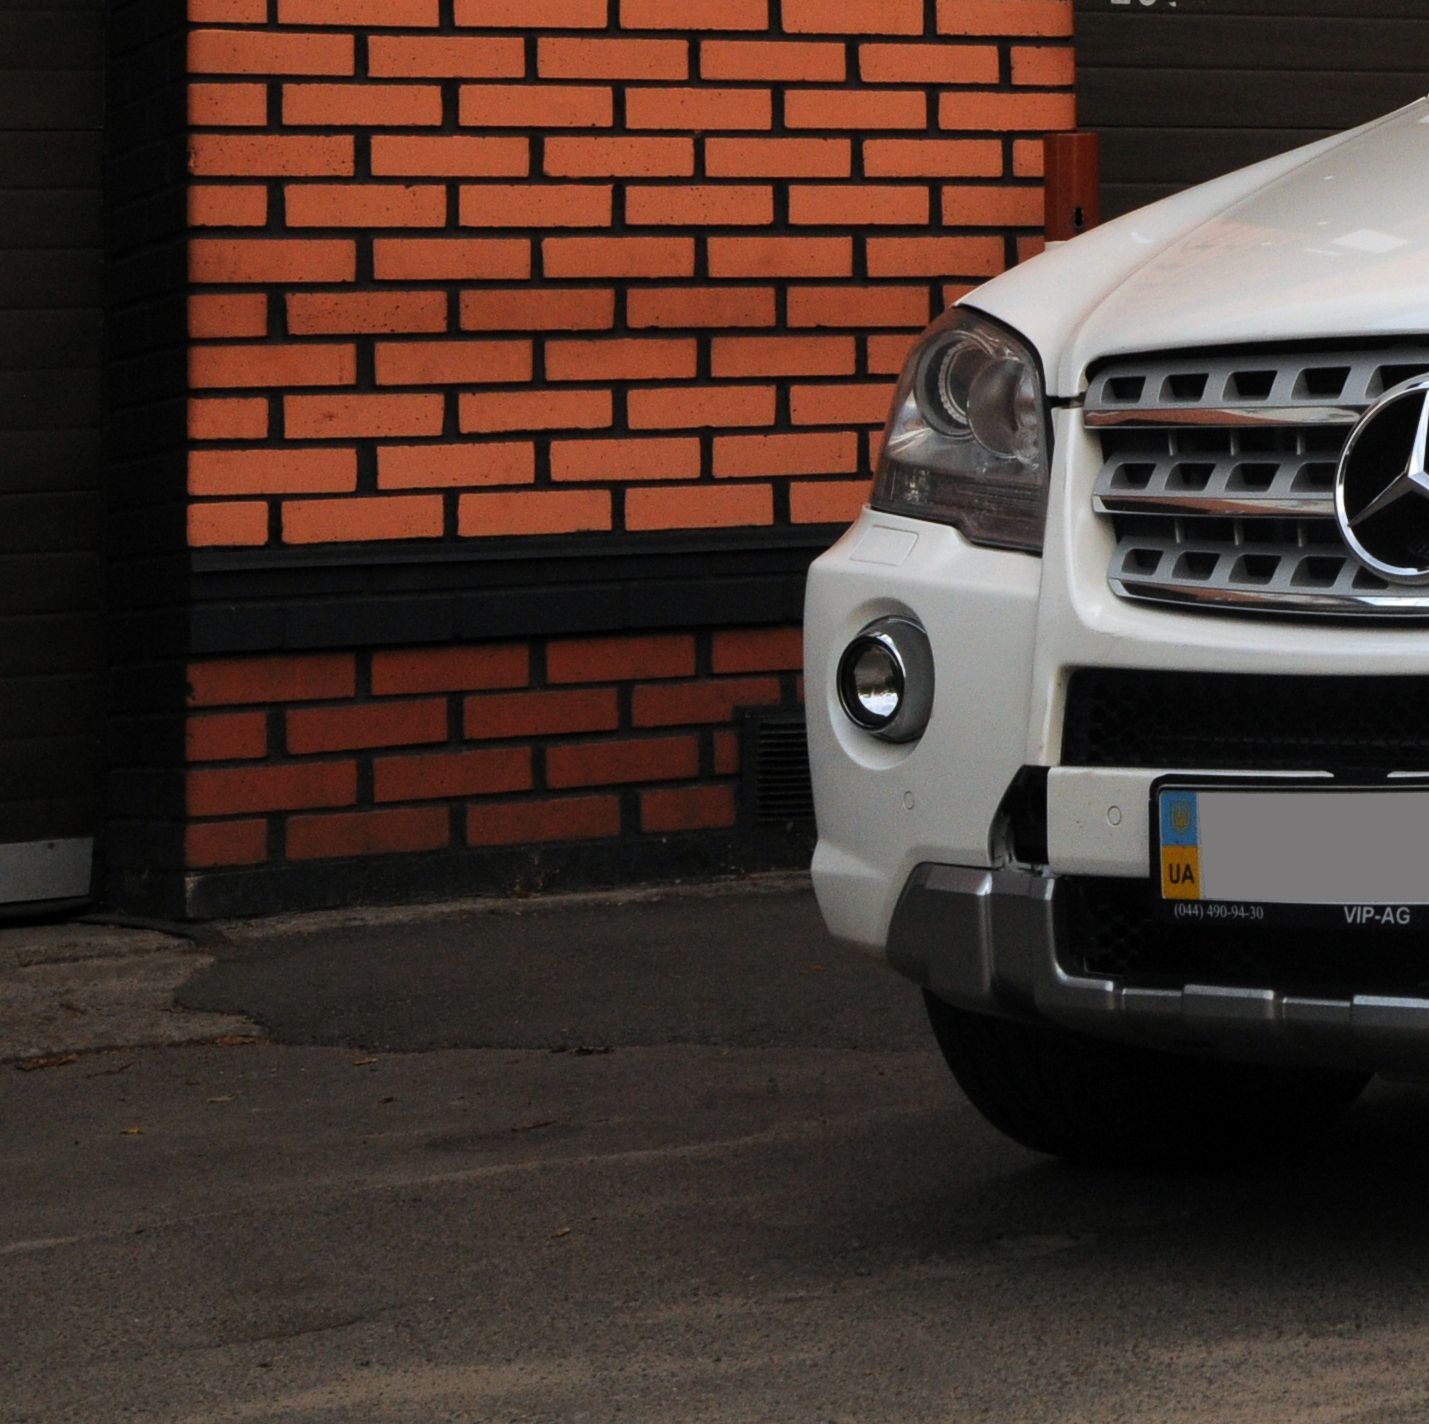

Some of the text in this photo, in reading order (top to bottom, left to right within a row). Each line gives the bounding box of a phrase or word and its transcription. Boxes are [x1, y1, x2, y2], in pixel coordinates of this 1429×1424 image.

[1169, 863, 1195, 885] UA
[1174, 903, 1265, 921] (044) 490-94-30
[1343, 905, 1411, 926] VIP-AG
